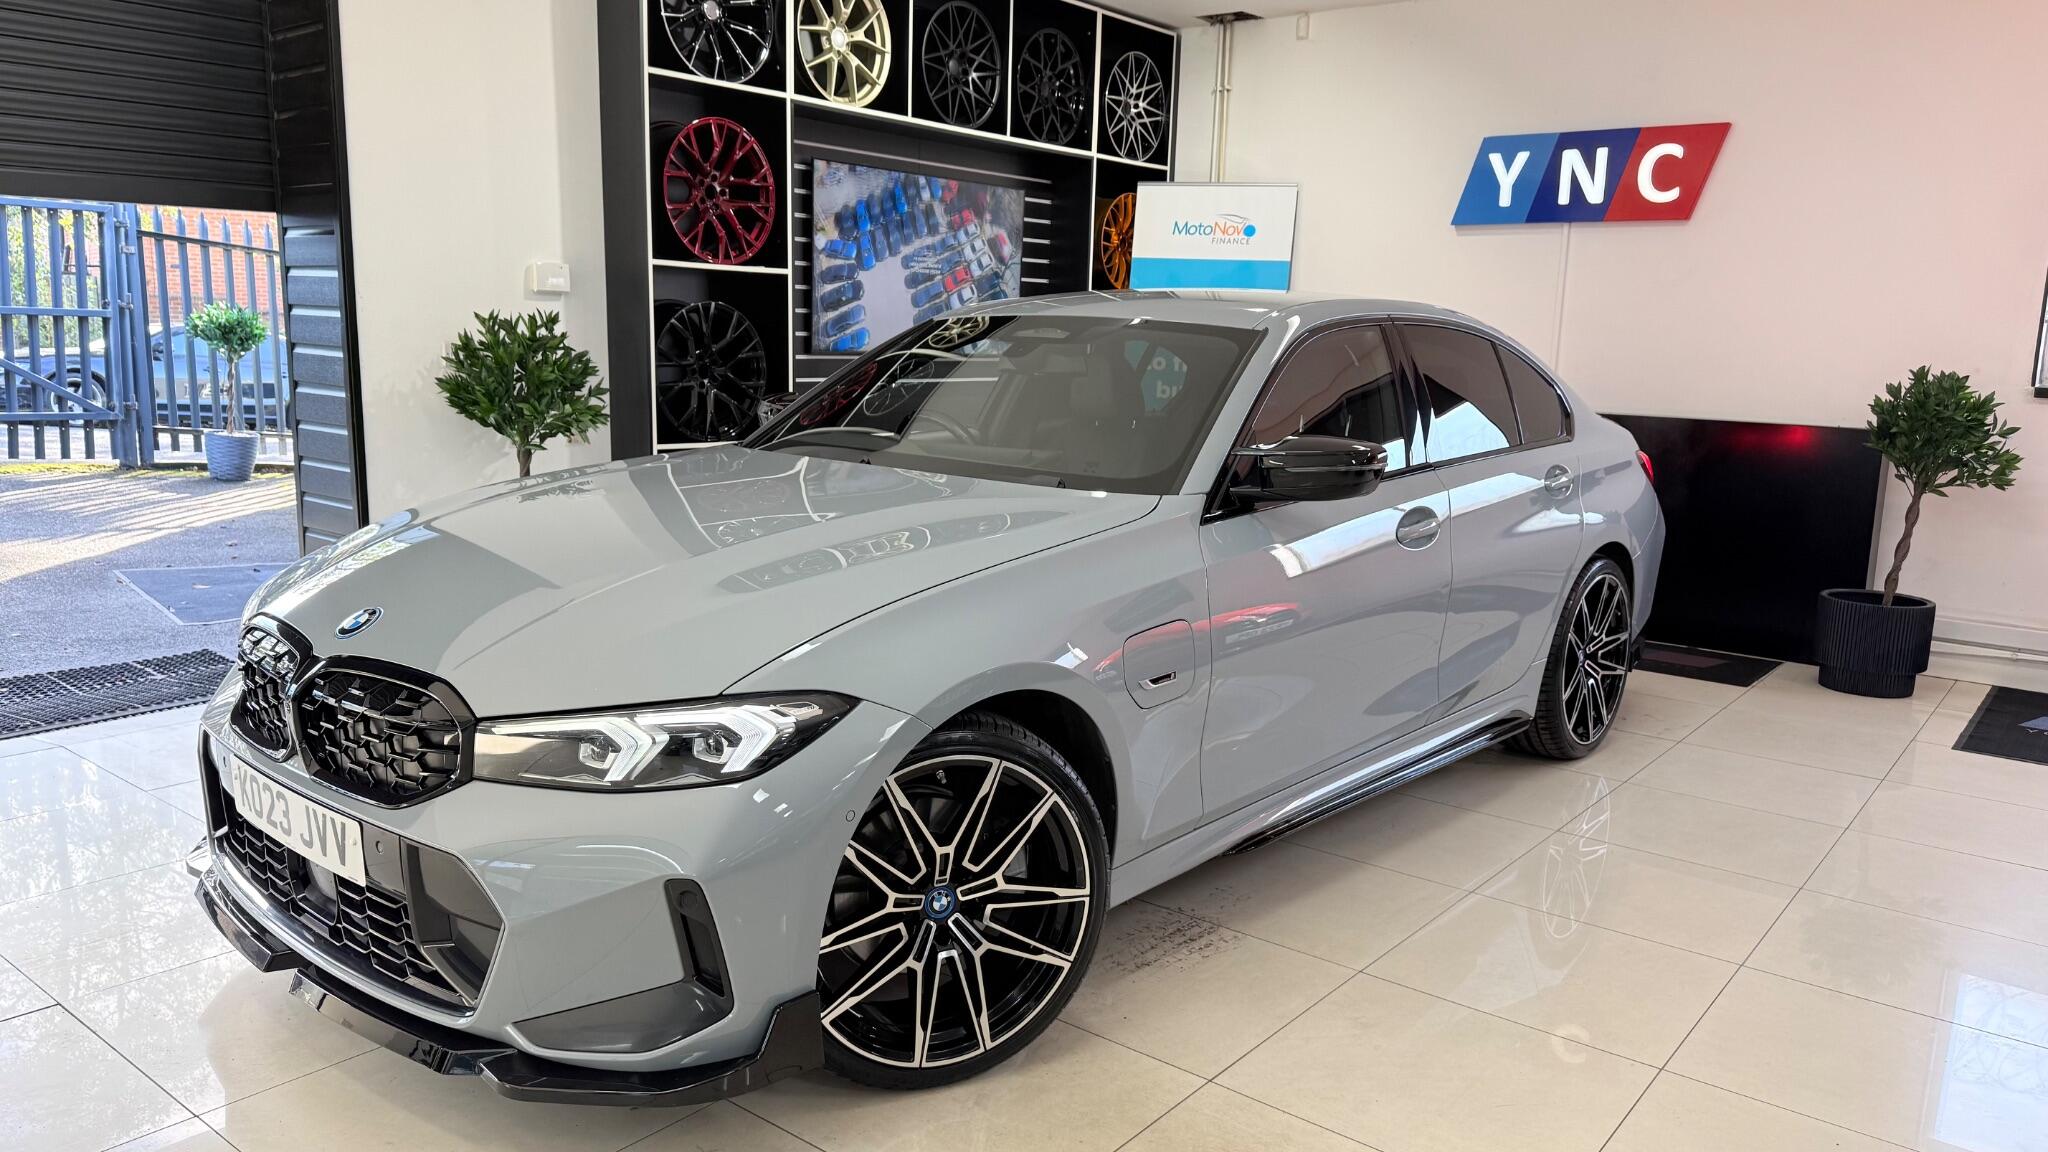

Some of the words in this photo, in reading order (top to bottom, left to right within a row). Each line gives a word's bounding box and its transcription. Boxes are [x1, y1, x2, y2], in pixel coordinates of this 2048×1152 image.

[1488, 143, 1684, 207] YNC
[1211, 237, 1250, 245] FINANCE
[301, 806, 346, 867] JVV
